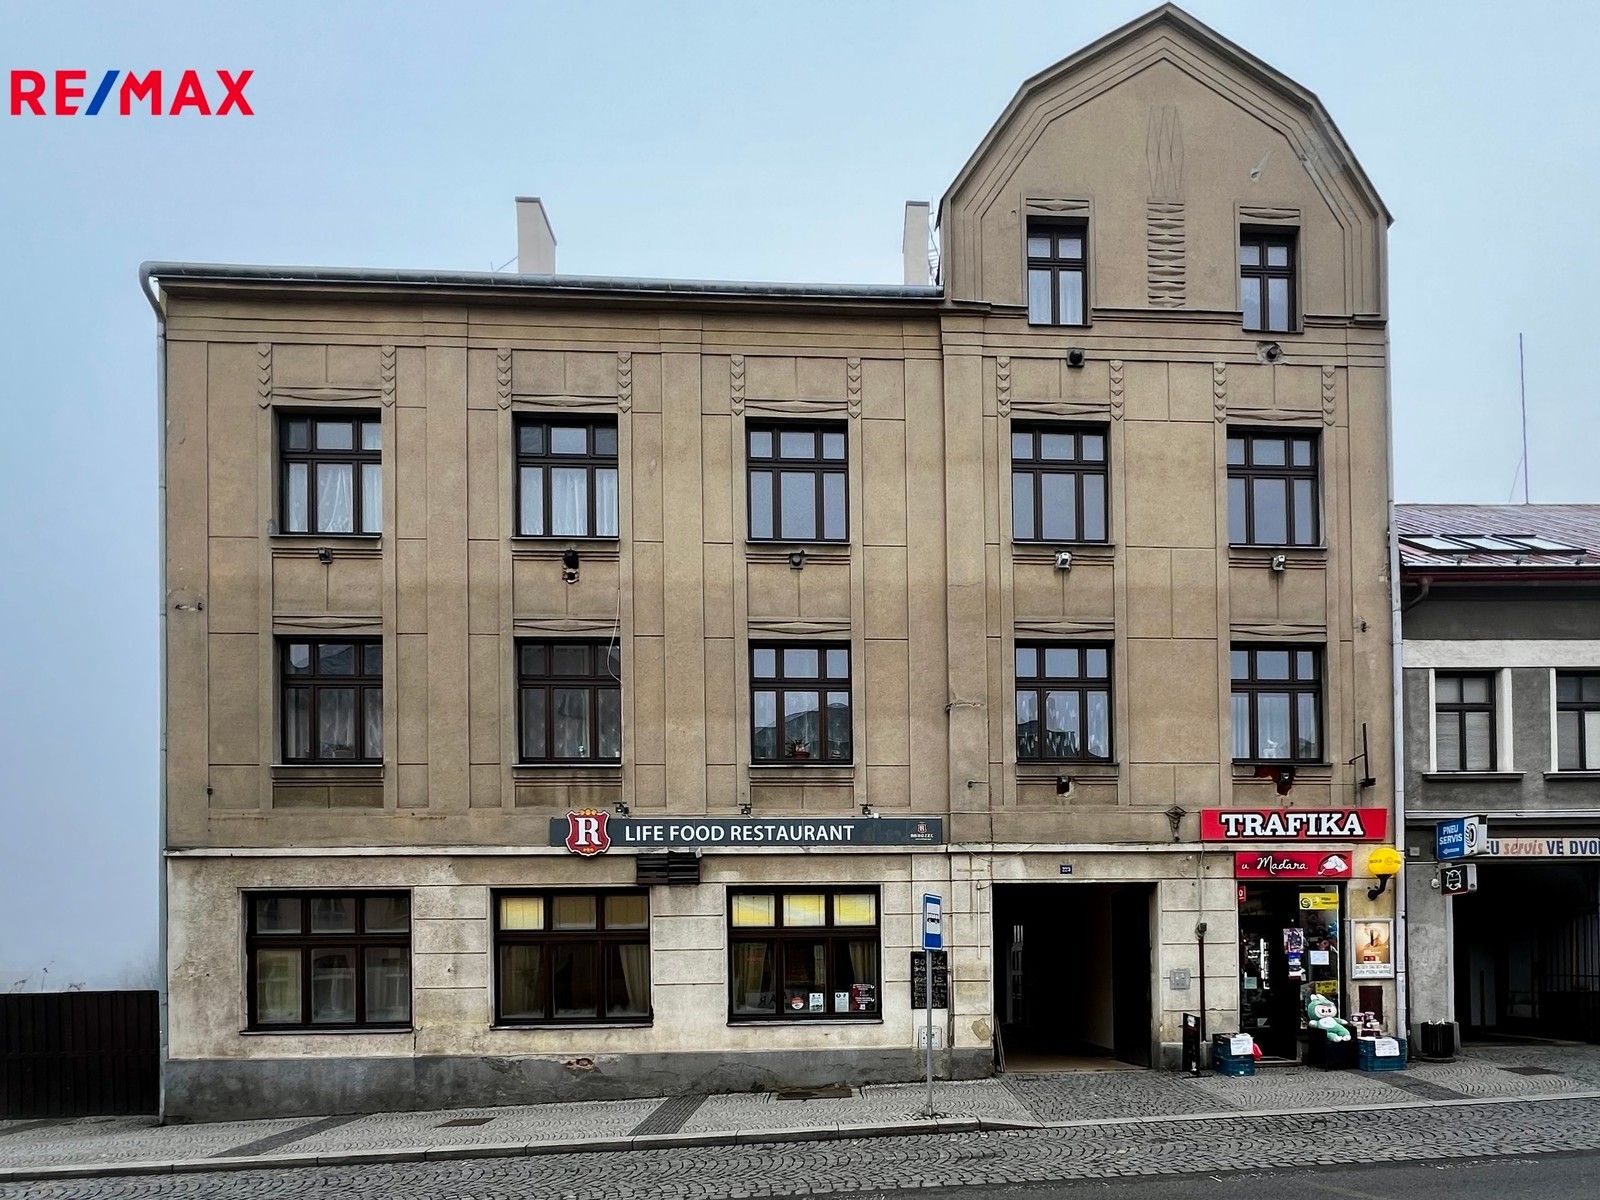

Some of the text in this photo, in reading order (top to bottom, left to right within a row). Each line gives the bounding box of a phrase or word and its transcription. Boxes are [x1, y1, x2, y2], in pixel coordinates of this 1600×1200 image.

[575, 817, 602, 846] R
[1221, 813, 1364, 836] TRAFIKA
[1443, 824, 1459, 834] PNEU
[625, 825, 854, 841] LIFE FOOD RESTAURANT
[1439, 831, 1463, 846] SERVIS
[1504, 840, 1543, 855] servis
[1546, 840, 1564, 855] VE
[1570, 840, 1600, 855] DVO
